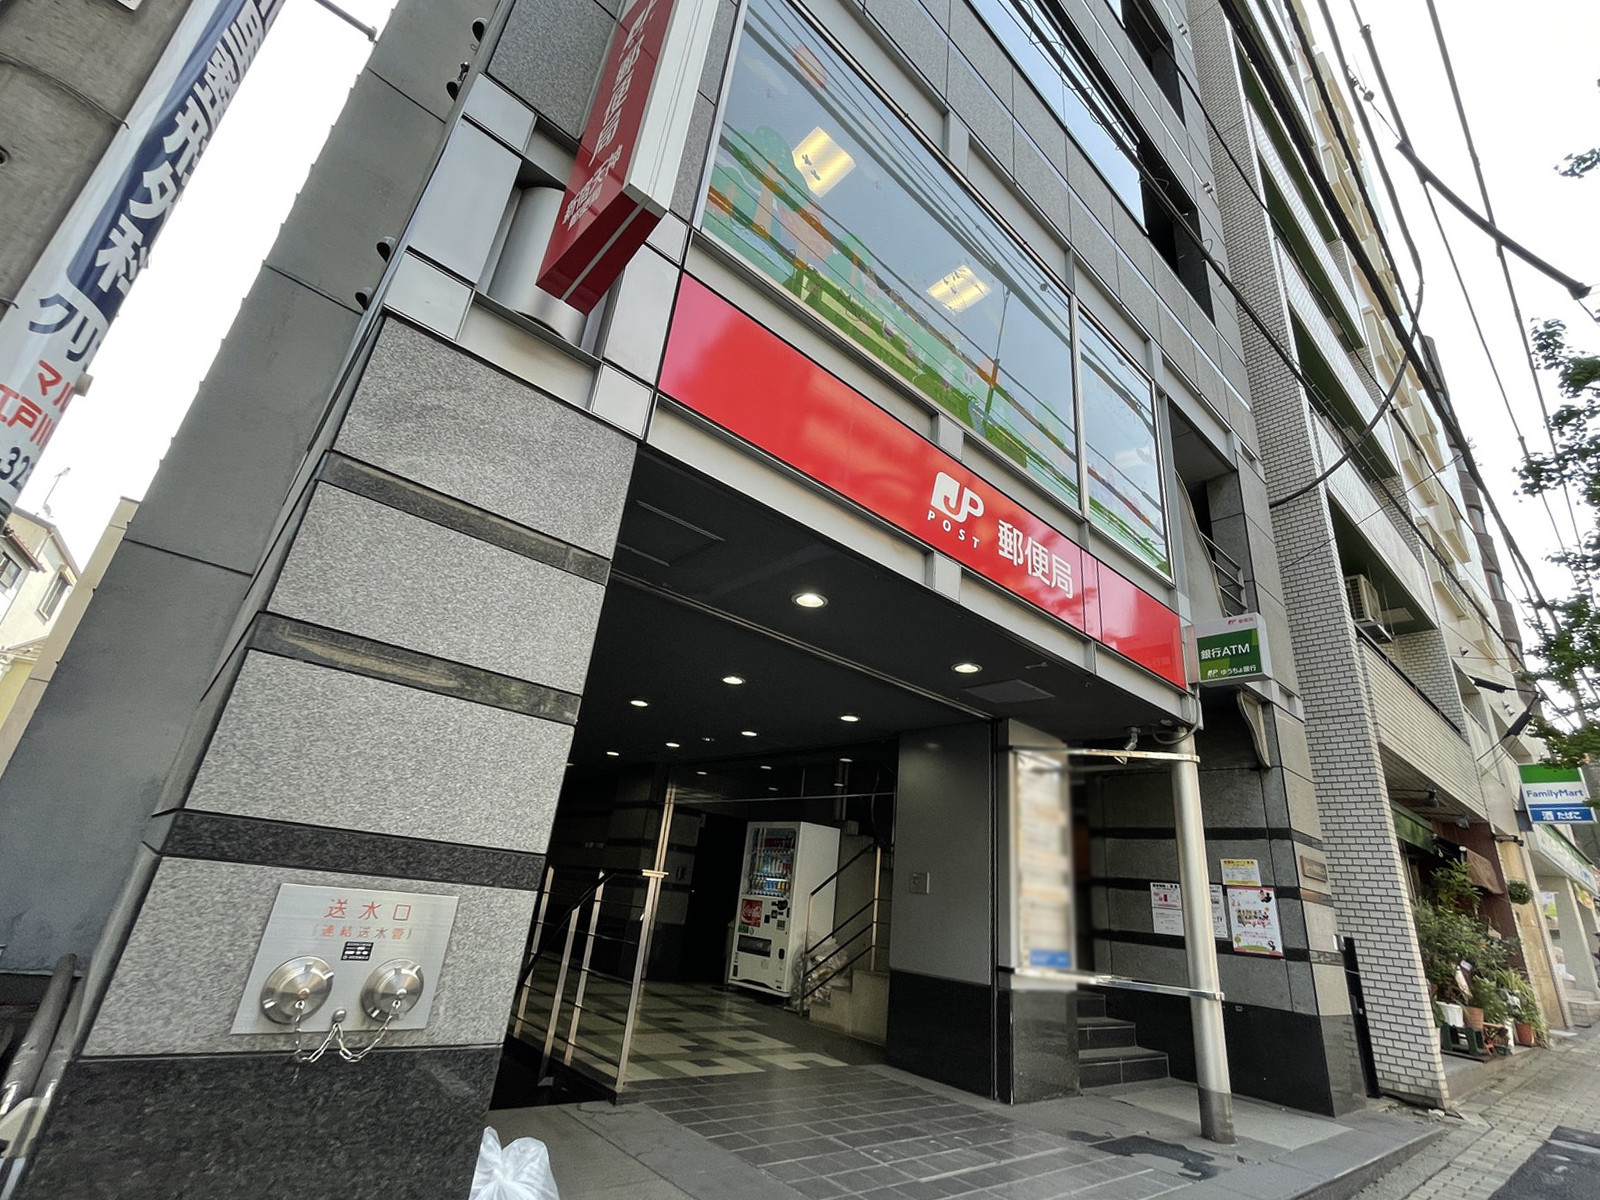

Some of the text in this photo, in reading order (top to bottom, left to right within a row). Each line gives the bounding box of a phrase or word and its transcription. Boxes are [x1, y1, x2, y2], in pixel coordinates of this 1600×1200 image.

[28, 293, 101, 373] クリ
[927, 509, 980, 549] POST
[998, 519, 1074, 599] 郵便局
[1200, 643, 1250, 660] 銀行ATM
[1220, 665, 1256, 675] ゆうちょ銀行
[1526, 789, 1584, 798] FamilyMart
[1556, 811, 1582, 820] たばこ
[324, 899, 412, 921] 送水口
